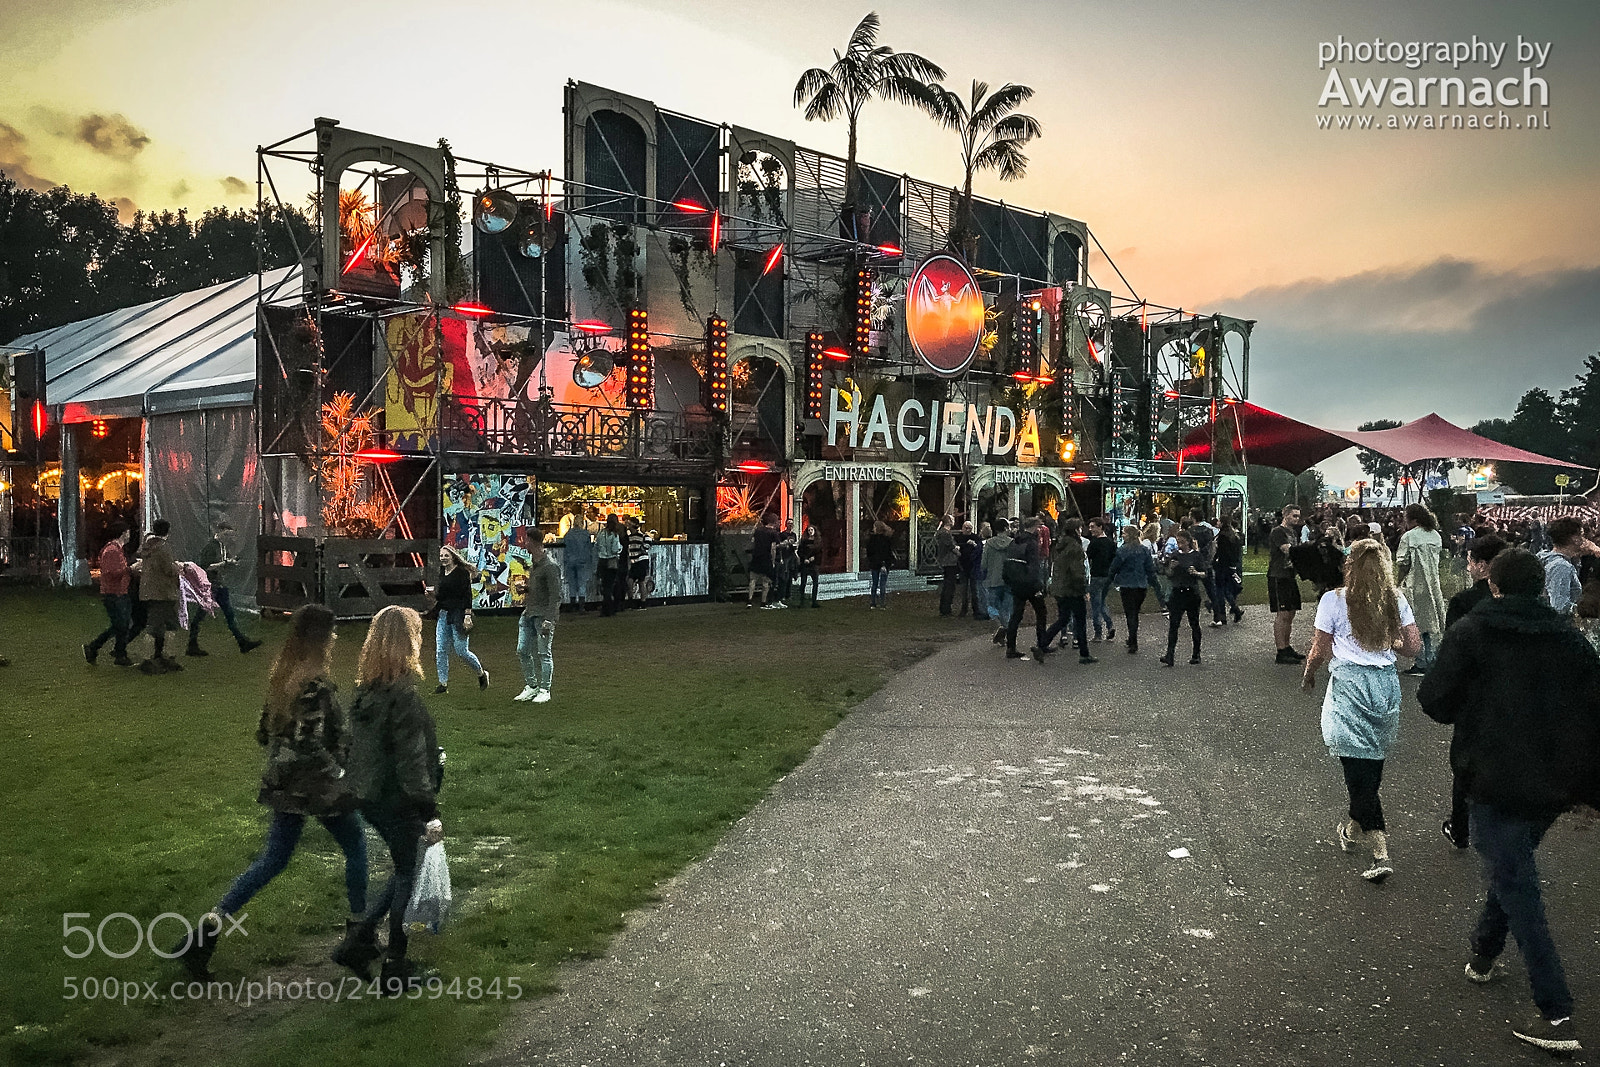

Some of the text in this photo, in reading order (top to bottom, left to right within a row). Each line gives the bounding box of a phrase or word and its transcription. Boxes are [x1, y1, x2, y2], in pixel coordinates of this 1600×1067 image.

[827, 388, 1041, 458] HACIENDA
[825, 466, 892, 481] ENTRANCE
[995, 470, 1047, 484] ENTRANCE
